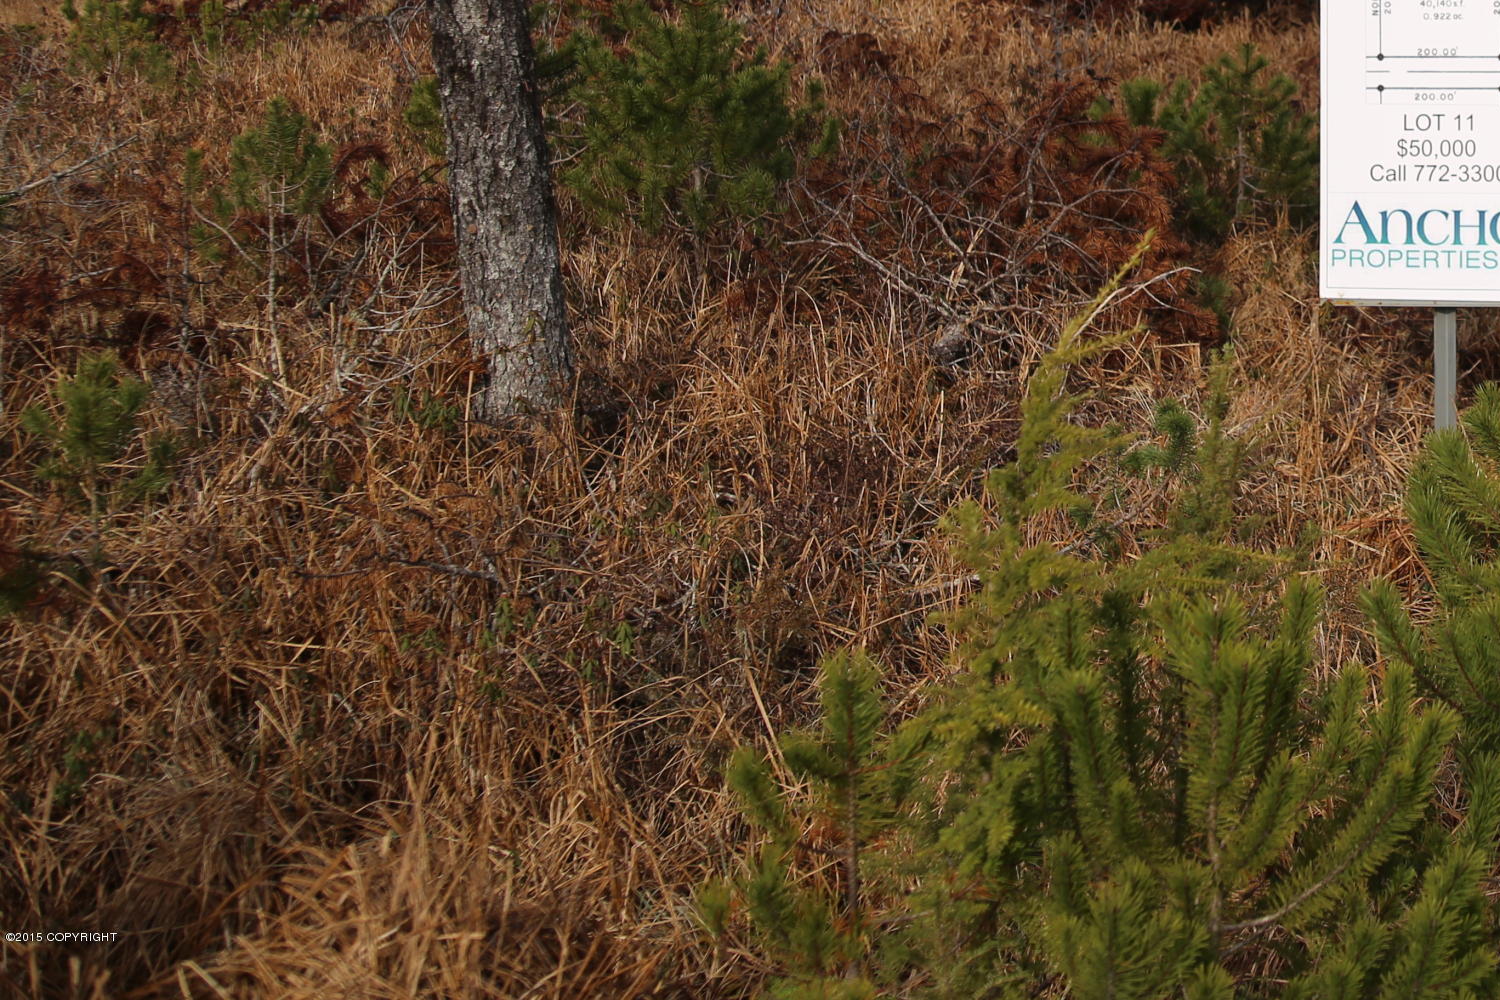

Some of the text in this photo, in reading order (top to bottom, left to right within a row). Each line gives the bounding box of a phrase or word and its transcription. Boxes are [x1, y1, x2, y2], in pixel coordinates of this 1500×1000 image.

[1402, 113, 1475, 131] LOT 11
[1396, 138, 1477, 159] $50,000
[1369, 164, 1407, 182] Call
[1331, 249, 1498, 269] PROPERTIES
